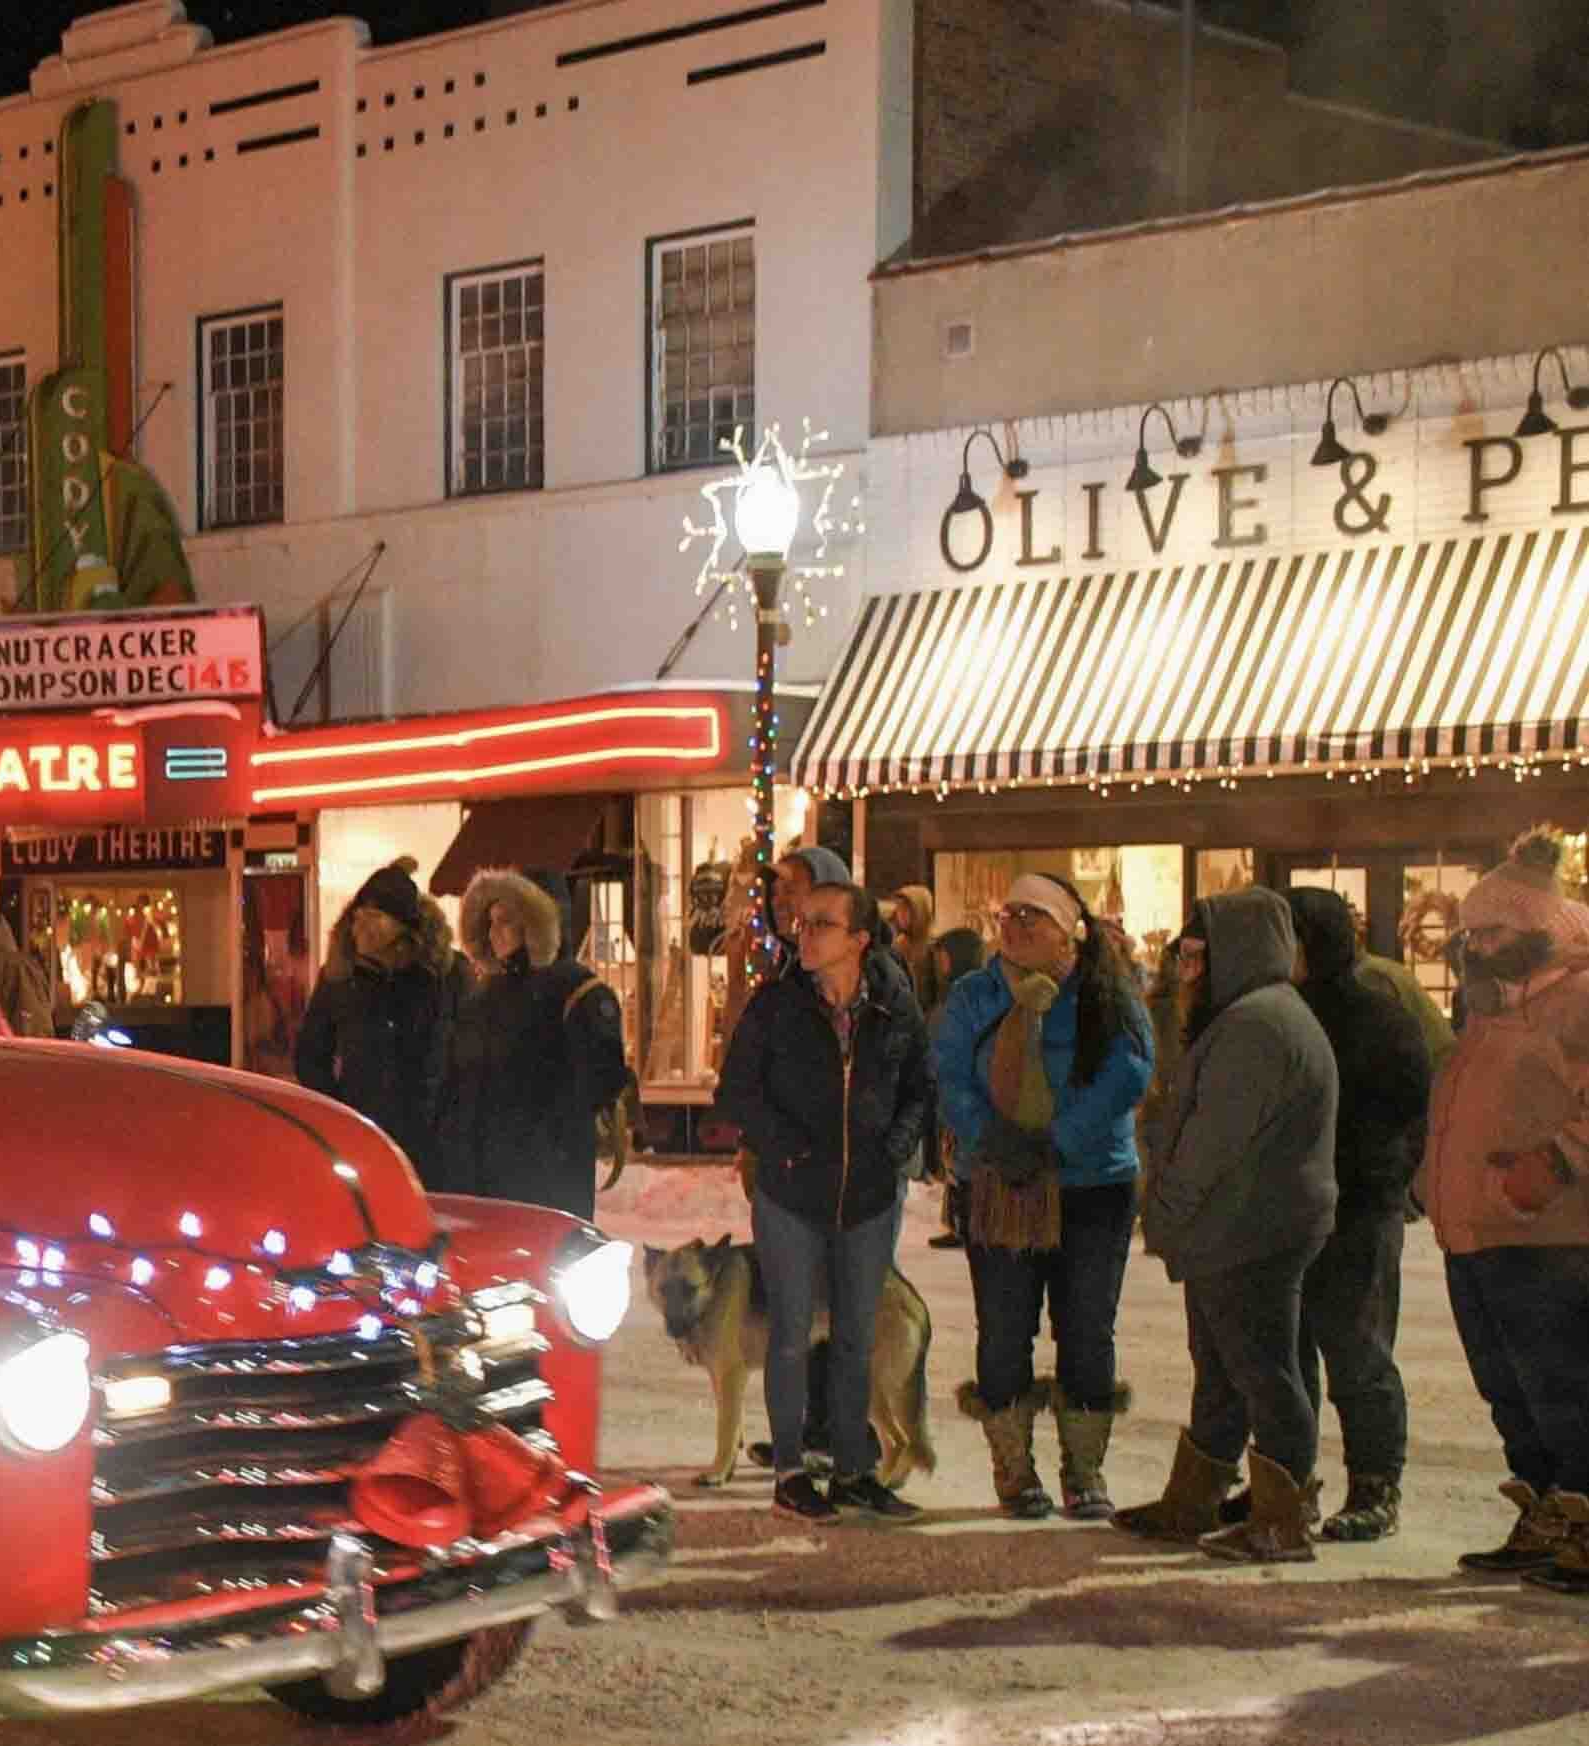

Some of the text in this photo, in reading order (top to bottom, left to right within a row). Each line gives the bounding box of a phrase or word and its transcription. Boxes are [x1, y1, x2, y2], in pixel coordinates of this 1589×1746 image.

[62, 383, 90, 548] CODY
[939, 426, 1589, 573] OLIVE & PE
